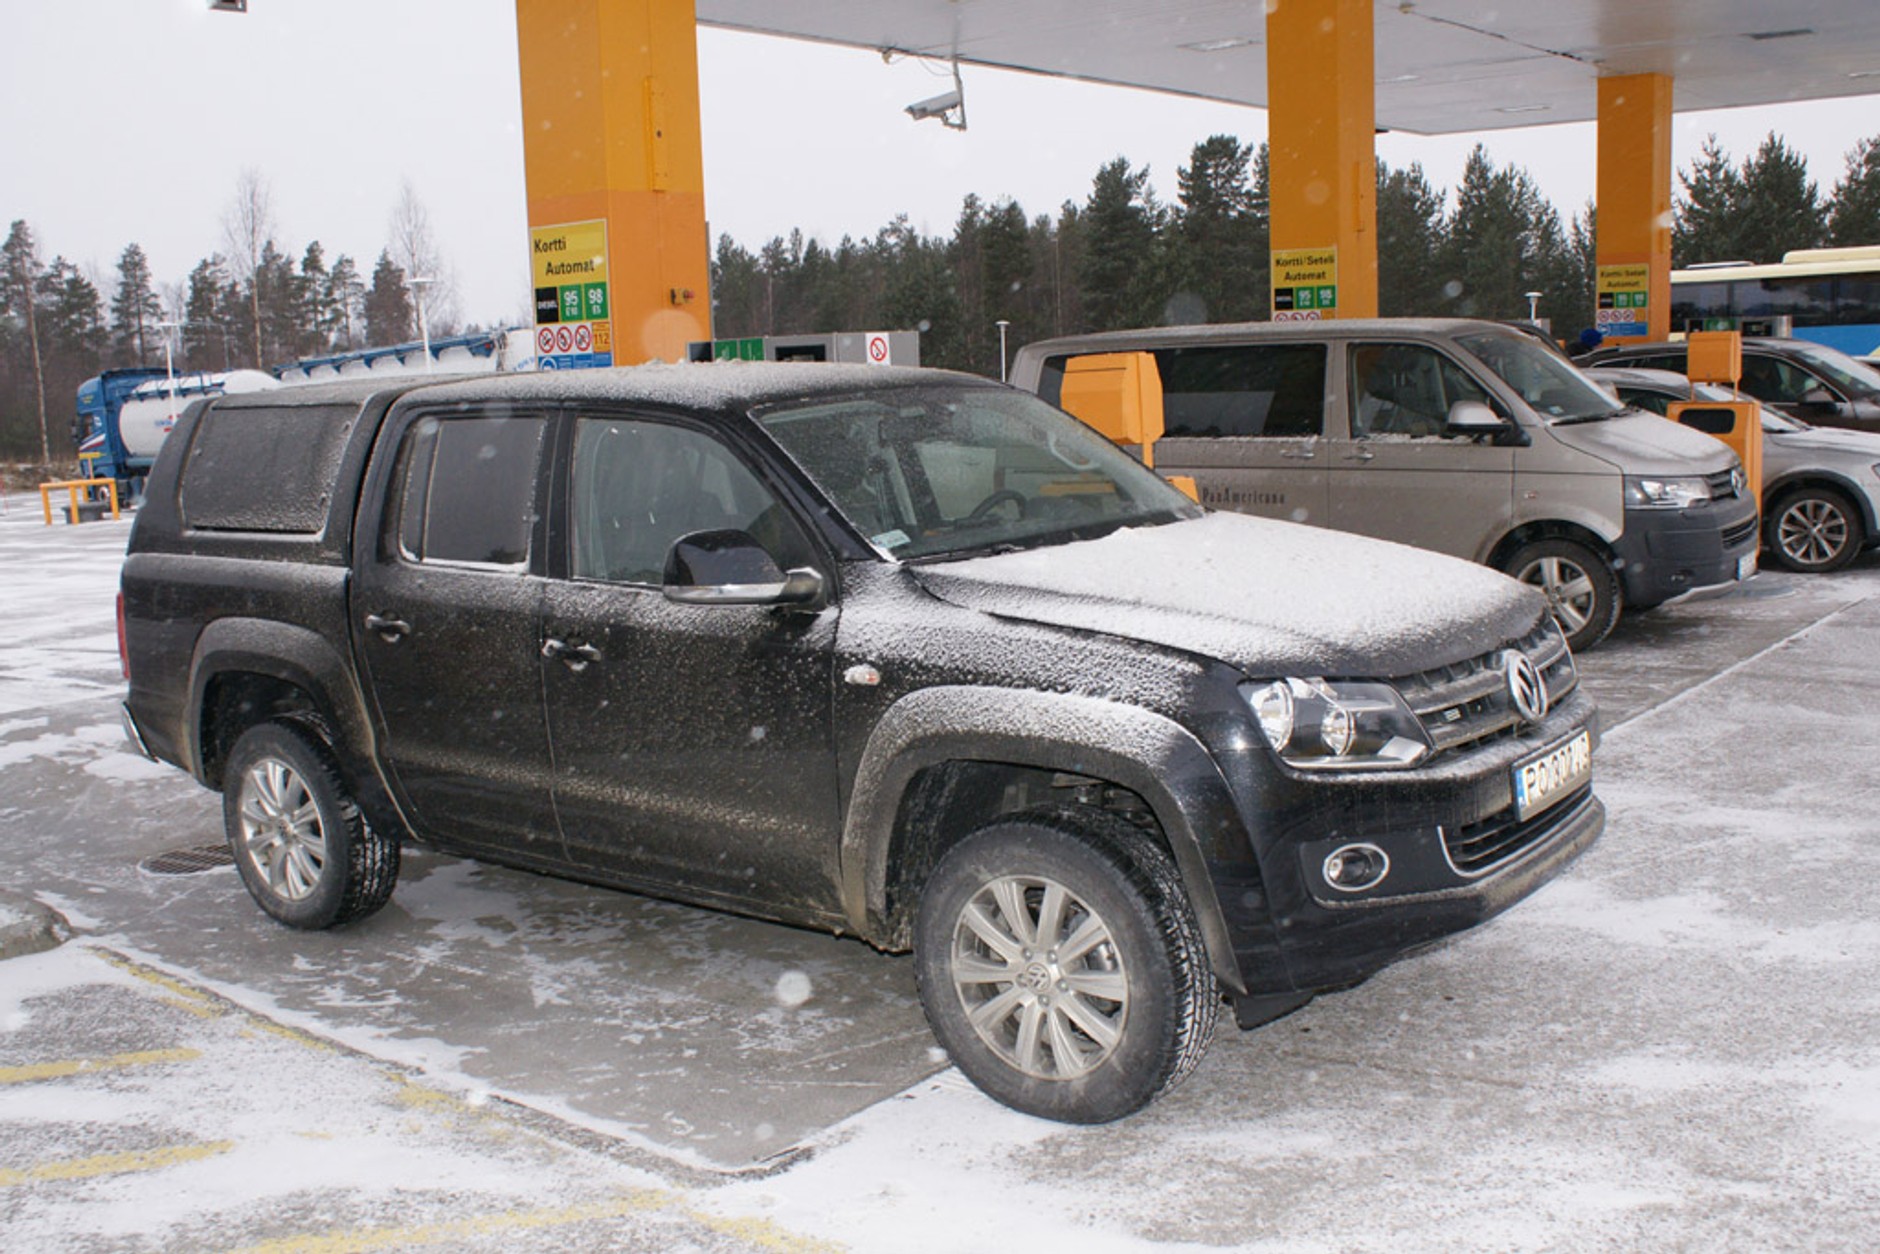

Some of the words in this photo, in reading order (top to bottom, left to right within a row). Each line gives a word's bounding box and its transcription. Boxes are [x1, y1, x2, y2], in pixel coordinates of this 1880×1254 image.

[534, 236, 567, 253] Kortti
[545, 259, 595, 276] Automat
[1284, 270, 1327, 281] Automat
[563, 289, 579, 306] 95
[587, 288, 604, 305] 98
[593, 332, 610, 346] 112
